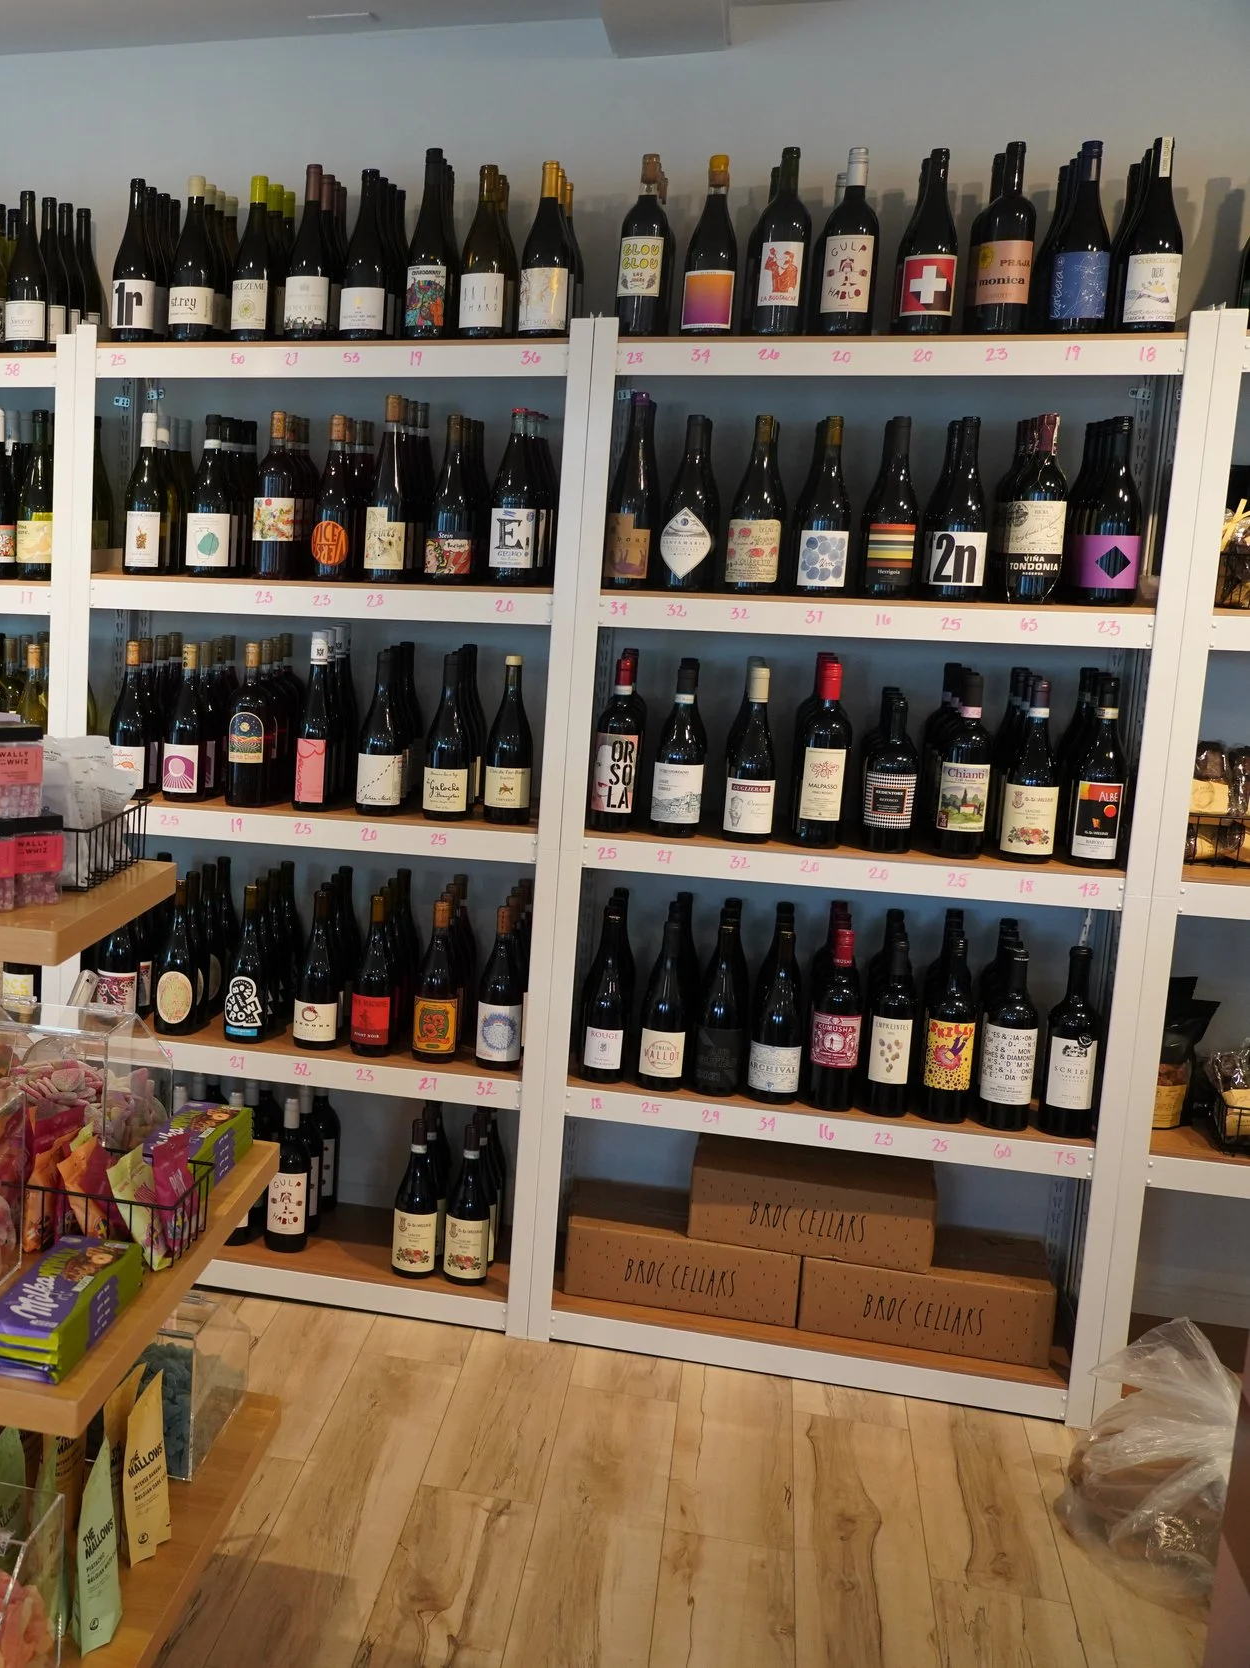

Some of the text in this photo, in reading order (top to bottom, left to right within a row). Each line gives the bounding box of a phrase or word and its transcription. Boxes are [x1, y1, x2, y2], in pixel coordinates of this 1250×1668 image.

[622, 244, 660, 256] GLOU
[621, 257, 659, 270] GLOU
[979, 276, 1025, 286] monica
[828, 288, 862, 300] HABLO
[114, 282, 143, 326] 1r
[111, 353, 127, 366] 25
[230, 353, 246, 366] 50
[285, 351, 299, 367] 27
[343, 352, 361, 364] 53
[409, 350, 422, 366] 19
[522, 349, 541, 366] 36
[626, 351, 643, 364] 28
[692, 347, 711, 363] 34
[759, 347, 781, 361] 26
[831, 350, 852, 363] 20
[913, 350, 935, 363] 20
[986, 348, 1008, 363] 23
[1065, 345, 1081, 362] 19
[1139, 347, 1156, 363] 18
[437, 532, 454, 540] Stein
[932, 533, 977, 585] 2n
[1024, 554, 1044, 562] VIÑA
[1009, 562, 1059, 572] TONDONIA
[256, 591, 274, 604] 23
[313, 594, 333, 607] 23
[367, 593, 384, 608] 28
[495, 598, 514, 613] 20
[610, 601, 628, 616] 34
[667, 604, 687, 618] 32
[730, 606, 750, 621] 32
[805, 610, 823, 624] 37
[874, 614, 891, 628] 16
[941, 616, 963, 632] 25
[1019, 618, 1038, 632] 63
[1097, 620, 1121, 636] 23
[611, 740, 634, 764] OR
[609, 763, 632, 785] SO
[947, 767, 986, 780] Chianti
[808, 782, 838, 790] MALPASSO
[606, 785, 629, 809] LA
[1099, 791, 1119, 803] ALBE
[160, 813, 179, 826] 25
[231, 817, 243, 831] 19
[295, 823, 312, 835] 25
[360, 828, 378, 841] 20
[431, 831, 447, 845] 25
[598, 846, 617, 860] 25
[657, 850, 673, 862] 27
[730, 855, 751, 869] 32
[947, 872, 967, 888] 25
[1019, 878, 1034, 893] 18
[1079, 882, 1100, 897] 43
[589, 1029, 620, 1041] ROUGE
[818, 1023, 854, 1033] KUMUSHA
[229, 1055, 245, 1072] 27
[293, 1063, 311, 1076] 32
[749, 1060, 798, 1076] ARCHIVAL
[356, 1068, 374, 1082] 23
[419, 1077, 437, 1092] 27
[476, 1081, 497, 1095] 32
[591, 1097, 604, 1110] 18
[641, 1101, 662, 1114] 25
[702, 1109, 721, 1124] 29
[757, 1116, 776, 1133] 34
[818, 1123, 836, 1143] 16
[874, 1131, 893, 1147] 23
[932, 1138, 954, 1153] 25
[1055, 1150, 1076, 1167] 75
[750, 1201, 867, 1245] BROC CELLARS
[625, 1258, 737, 1298] BROC CELLARS
[10, 1274, 59, 1319] Milka
[863, 1293, 984, 1337] BROC CELLARS
[128, 1444, 163, 1478] MALLOWS
[83, 1526, 96, 1546] THE
[85, 1519, 114, 1560] MALLOWS
